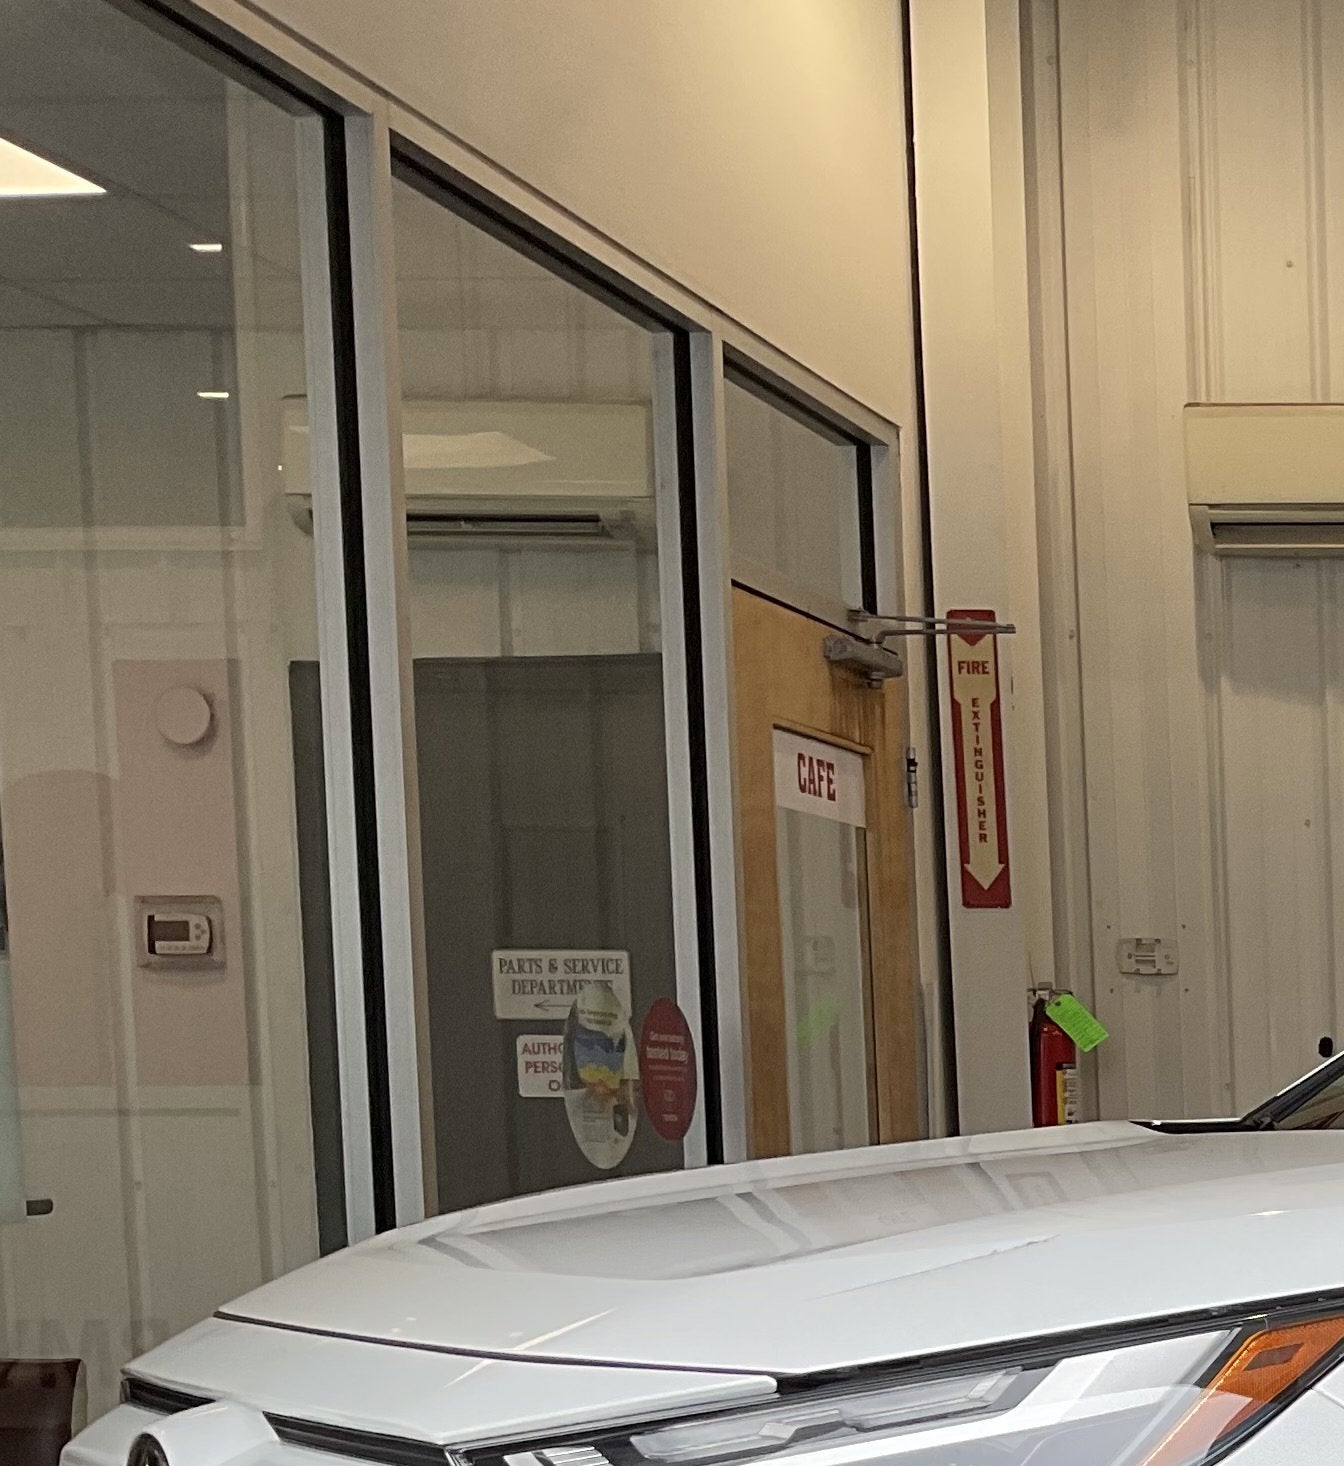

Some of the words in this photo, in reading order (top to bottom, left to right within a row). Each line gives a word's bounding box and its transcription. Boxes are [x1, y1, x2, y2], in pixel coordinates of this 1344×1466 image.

[957, 660, 990, 675] FIRE
[797, 752, 836, 802] CAFE
[971, 697, 988, 844] EXTINGUISHER
[498, 957, 543, 975] PARTS
[548, 958, 558, 974] &
[563, 958, 624, 975] SERVICE
[511, 979, 613, 996] DEPARTM
[525, 1060, 563, 1075] PERS
